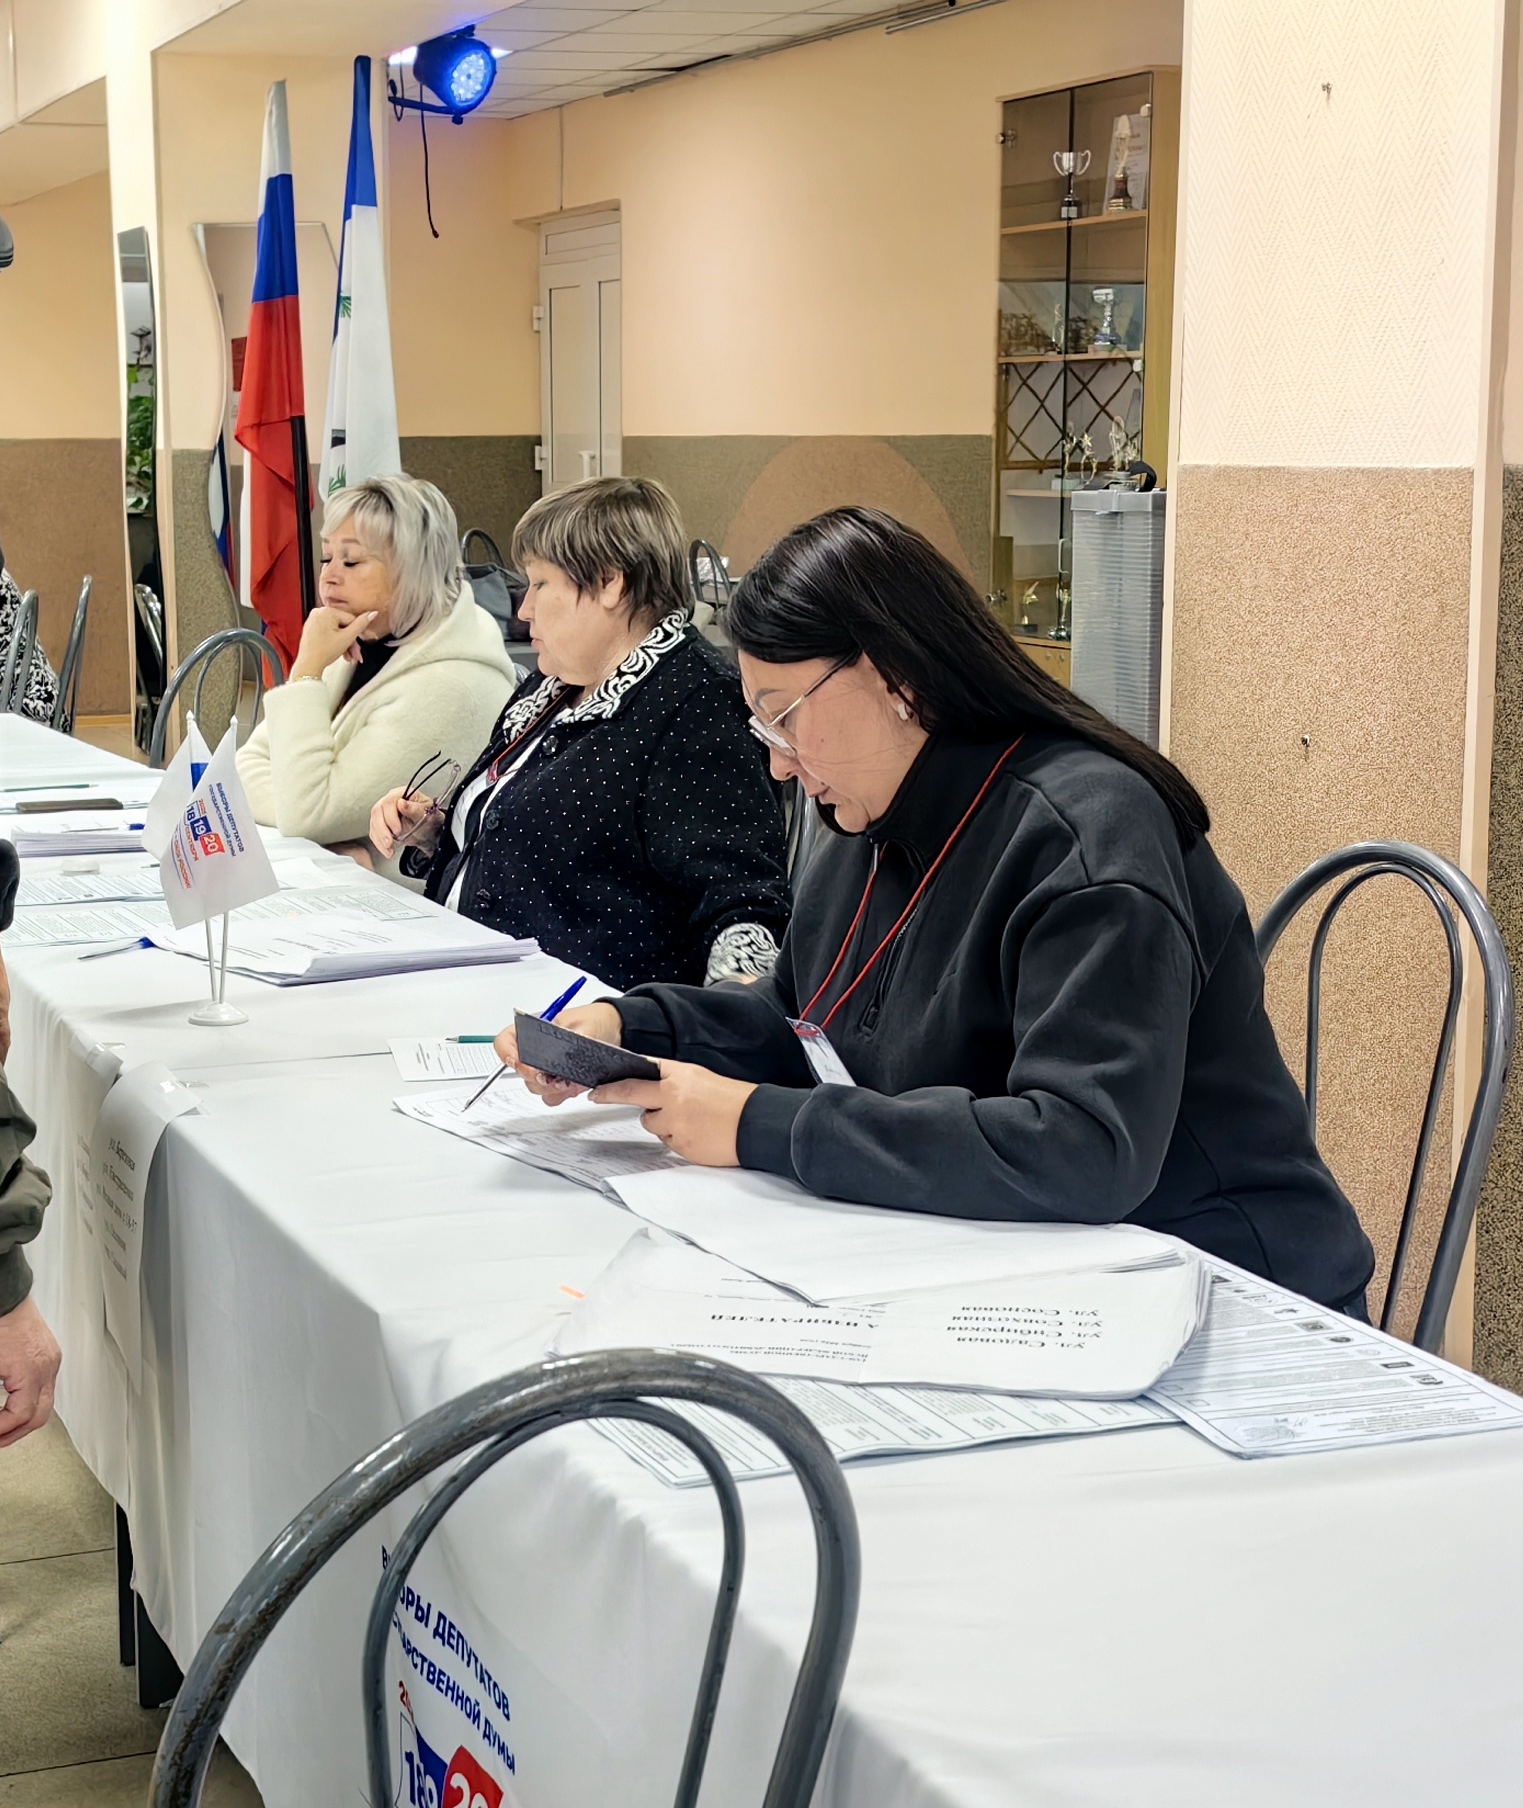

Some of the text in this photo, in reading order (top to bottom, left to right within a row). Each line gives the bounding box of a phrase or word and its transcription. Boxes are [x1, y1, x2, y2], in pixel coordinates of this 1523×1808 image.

[186, 806, 219, 853] 18 19 20
[961, 1306, 1061, 1316] Сосновая
[947, 1326, 1062, 1338] Сибирская
[956, 1336, 1045, 1348] Садовая
[432, 1610, 511, 1722] ДЕПУТАТОВ
[482, 1716, 516, 1776] ДУМЫ
